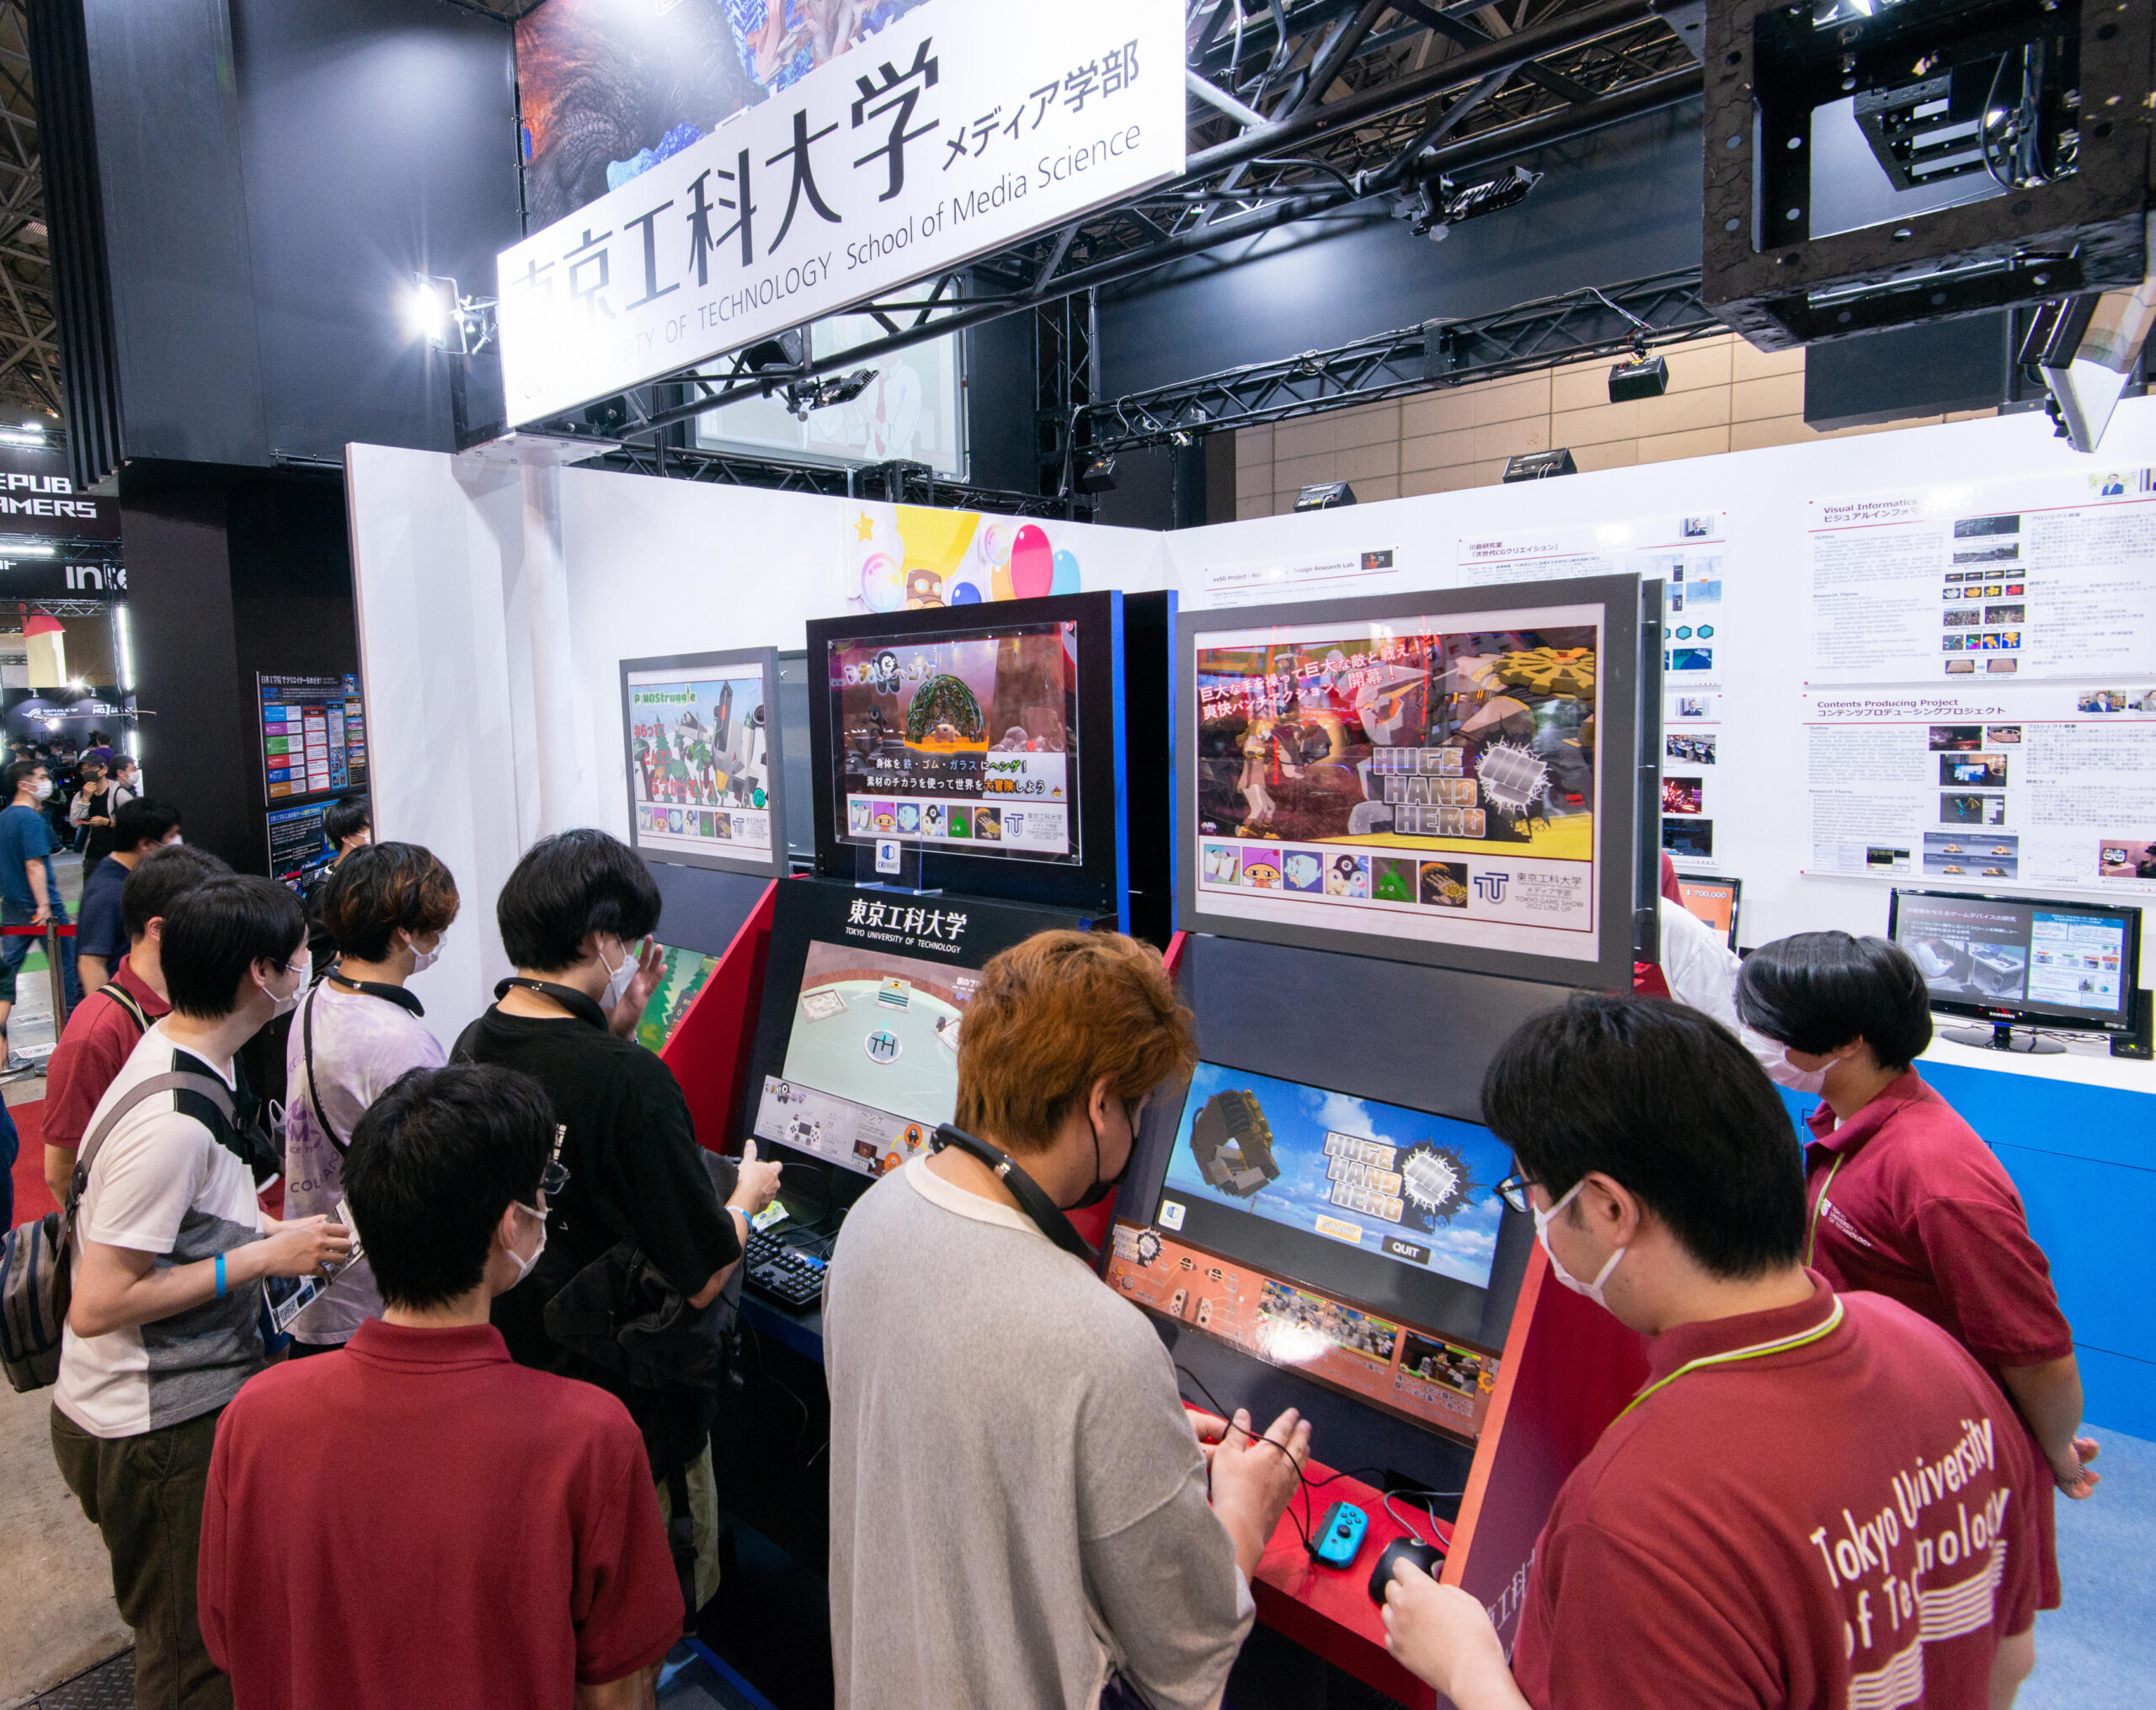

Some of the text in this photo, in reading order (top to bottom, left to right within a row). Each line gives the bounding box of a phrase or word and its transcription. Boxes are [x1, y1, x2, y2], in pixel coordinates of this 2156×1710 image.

[942, 38, 1139, 172] メディア学部
[665, 125, 1141, 344] OF TECHNOLOGY School of Media Science
[1824, 498, 1919, 514] Visual Informatics
[1228, 573, 1247, 583] Project
[1314, 562, 1341, 573] Research
[1341, 561, 1354, 569] Lab
[1817, 706, 2007, 717] コンテンツプロデューシングプロジェクト
[1865, 699, 1917, 709] Producing
[1920, 698, 1959, 707] Project
[1373, 746, 1465, 777] HUGE
[867, 775, 1045, 794] 素材のチカラを使って世界を大冒険しよう
[1384, 775, 1478, 807] HAND
[1395, 804, 1486, 839] HERO
[1517, 872, 1582, 887] 東京工科大学
[1526, 887, 1572, 898] メディア学部
[1515, 895, 1584, 908] TOKYO GAME SHOW
[847, 898, 968, 941] 東京工科大学
[846, 926, 962, 955] TOKYO UNIVERSITY OF TECHNOLOGY
[1323, 1132, 1398, 1171] HUGE
[1327, 1156, 1402, 1197] HAND
[1331, 1180, 1405, 1223] HERO
[1322, 1221, 1356, 1237] START
[1392, 1242, 1421, 1258] QUIT
[1809, 1507, 1900, 1589] Tokyo
[1882, 1487, 2010, 1632] Tenology
